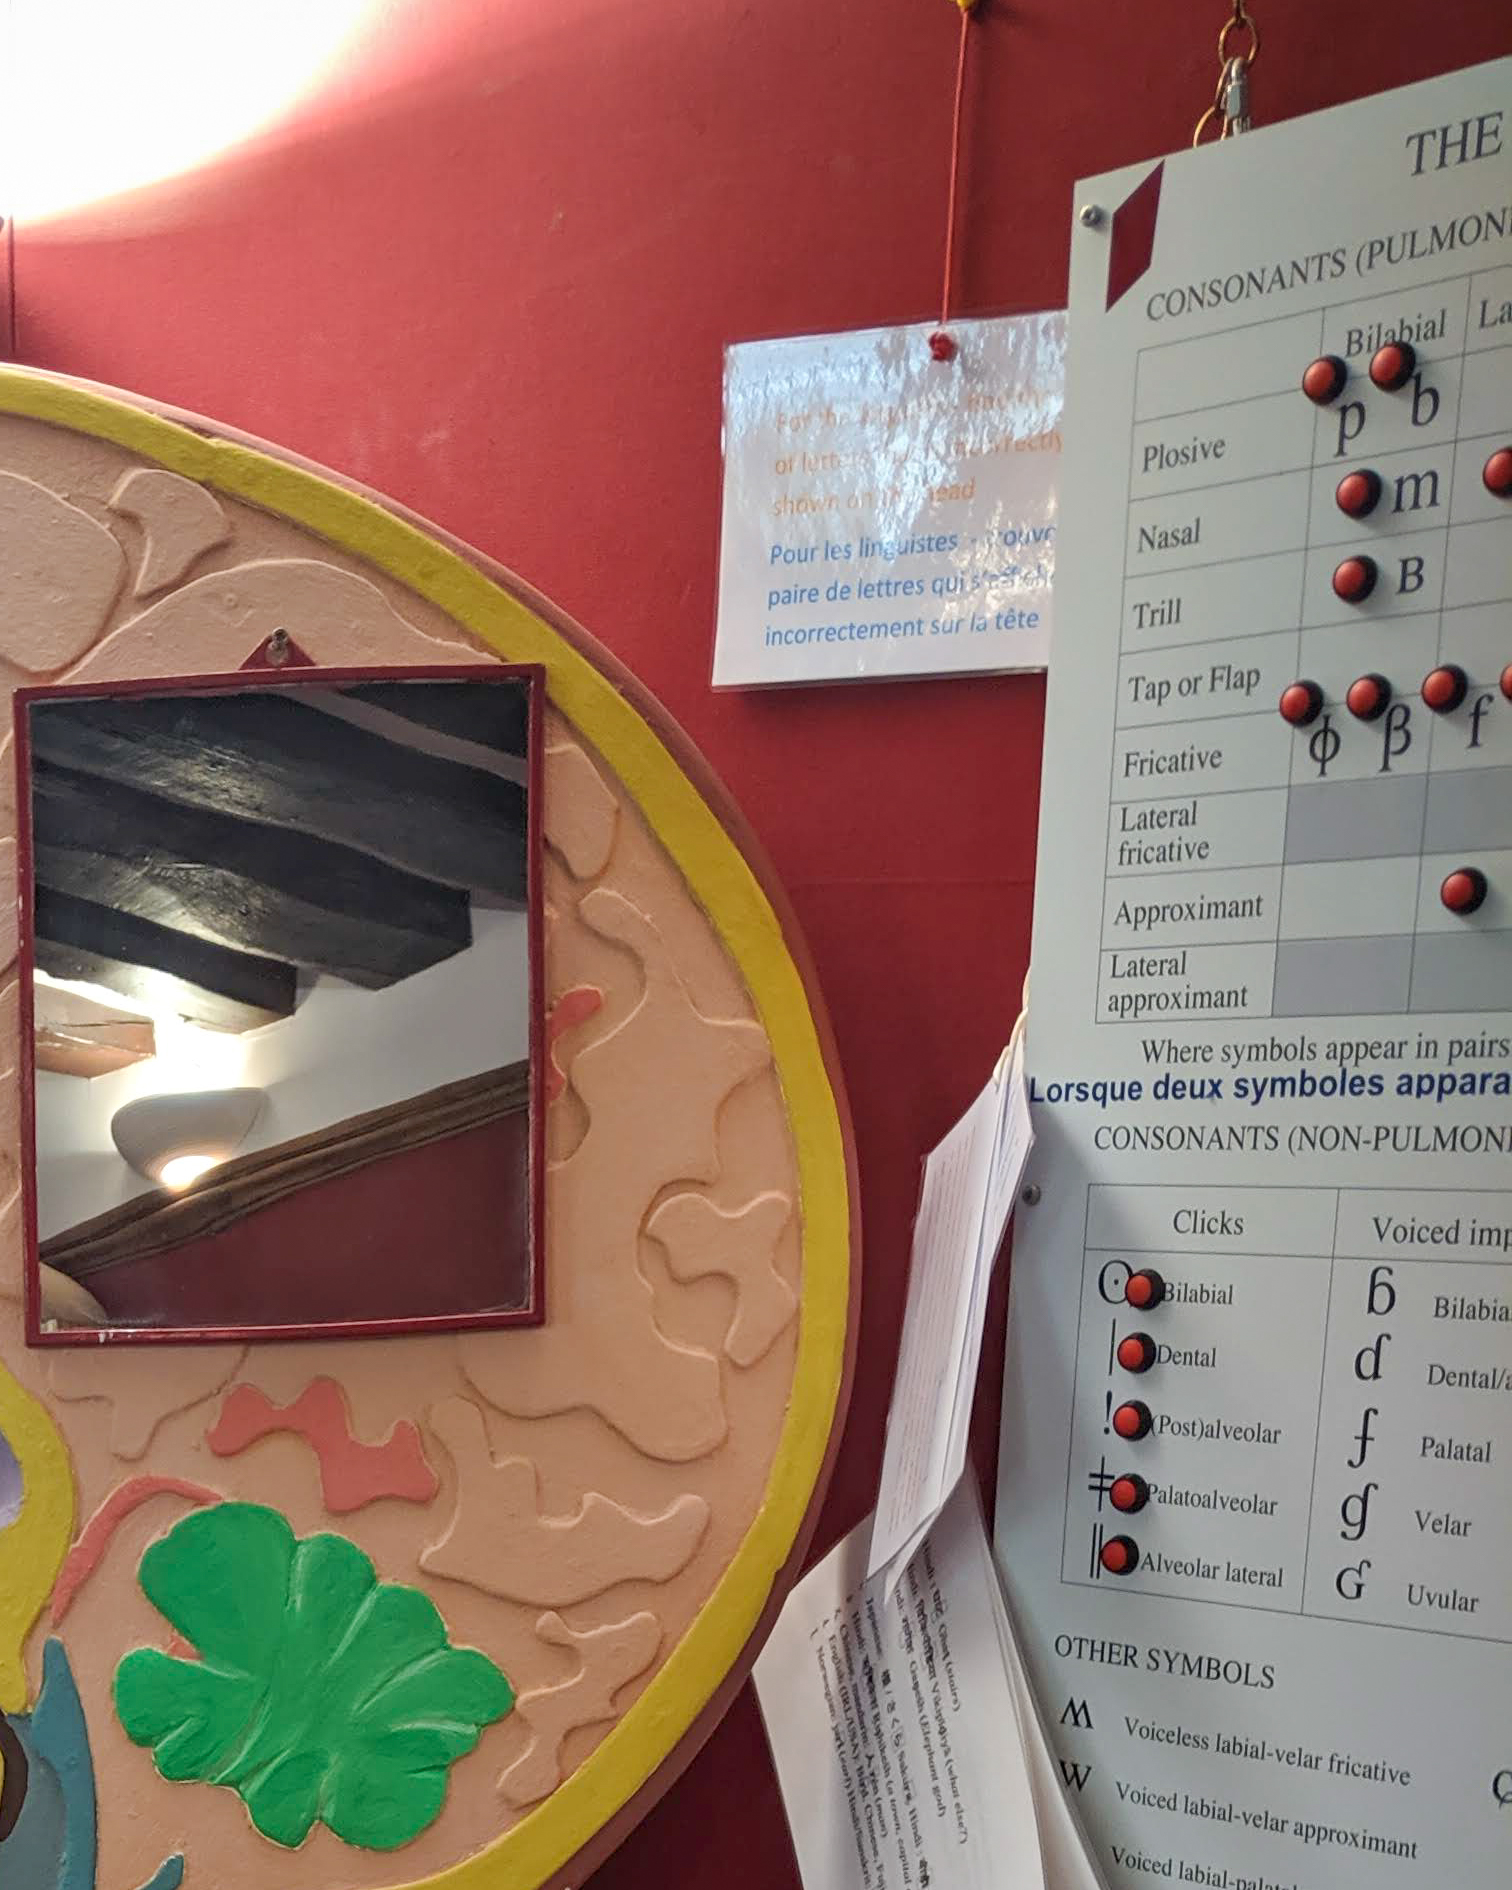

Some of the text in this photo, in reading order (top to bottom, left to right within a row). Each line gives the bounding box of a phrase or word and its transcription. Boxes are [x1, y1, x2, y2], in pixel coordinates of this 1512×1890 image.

[1406, 111, 1504, 176] THE
[1146, 249, 1346, 320] CONSONANTS
[1345, 309, 1447, 357] Bilabial
[1410, 367, 1440, 427] b
[1334, 400, 1366, 458] p
[1142, 437, 1226, 472] Plosive
[1391, 465, 1441, 515] m
[770, 534, 958, 565] Pour les linguistes
[1136, 516, 1202, 555] Nasal
[768, 587, 819, 610] paire
[826, 580, 851, 601] de
[858, 578, 924, 600] lettres
[932, 574, 964, 596] qui
[765, 608, 1039, 646] incorrectement sur la tête
[1132, 598, 1182, 630] Trill
[1128, 664, 1261, 704] Tap or Flap
[1124, 746, 1223, 778] Fricative
[1120, 801, 1198, 833] Lateral
[1118, 838, 1211, 866] fricative
[1113, 894, 1263, 931] Approximant
[1111, 951, 1187, 980] Lateral
[1107, 984, 1249, 1019] approximant
[1141, 1030, 1511, 1074] Where symbols appear in pairs
[1028, 1069, 1511, 1109] Lorsque deux symboles appara
[1094, 1124, 1279, 1152] CONSONANTS
[1172, 1209, 1245, 1237] Clicks
[1373, 1216, 1460, 1246] Voiced
[1162, 1280, 1234, 1306] Bilabial
[1156, 1345, 1217, 1369] Dental
[1151, 1411, 1282, 1447] (Post)alveolar
[1421, 1435, 1492, 1464] Palatal
[1145, 1483, 1279, 1517] Palatoalveolar
[1415, 1509, 1472, 1537] Velar
[1141, 1550, 1284, 1589] Alveolar lateral
[1408, 1584, 1480, 1614] Uvular
[1055, 1634, 1276, 1691] OTHER SYMBOLS
[1125, 1716, 1411, 1786] Voiceless labial-velar fricative
[1116, 1781, 1418, 1860] Voiced labial-velar approximant
[1111, 1846, 1172, 1877] Voiced
